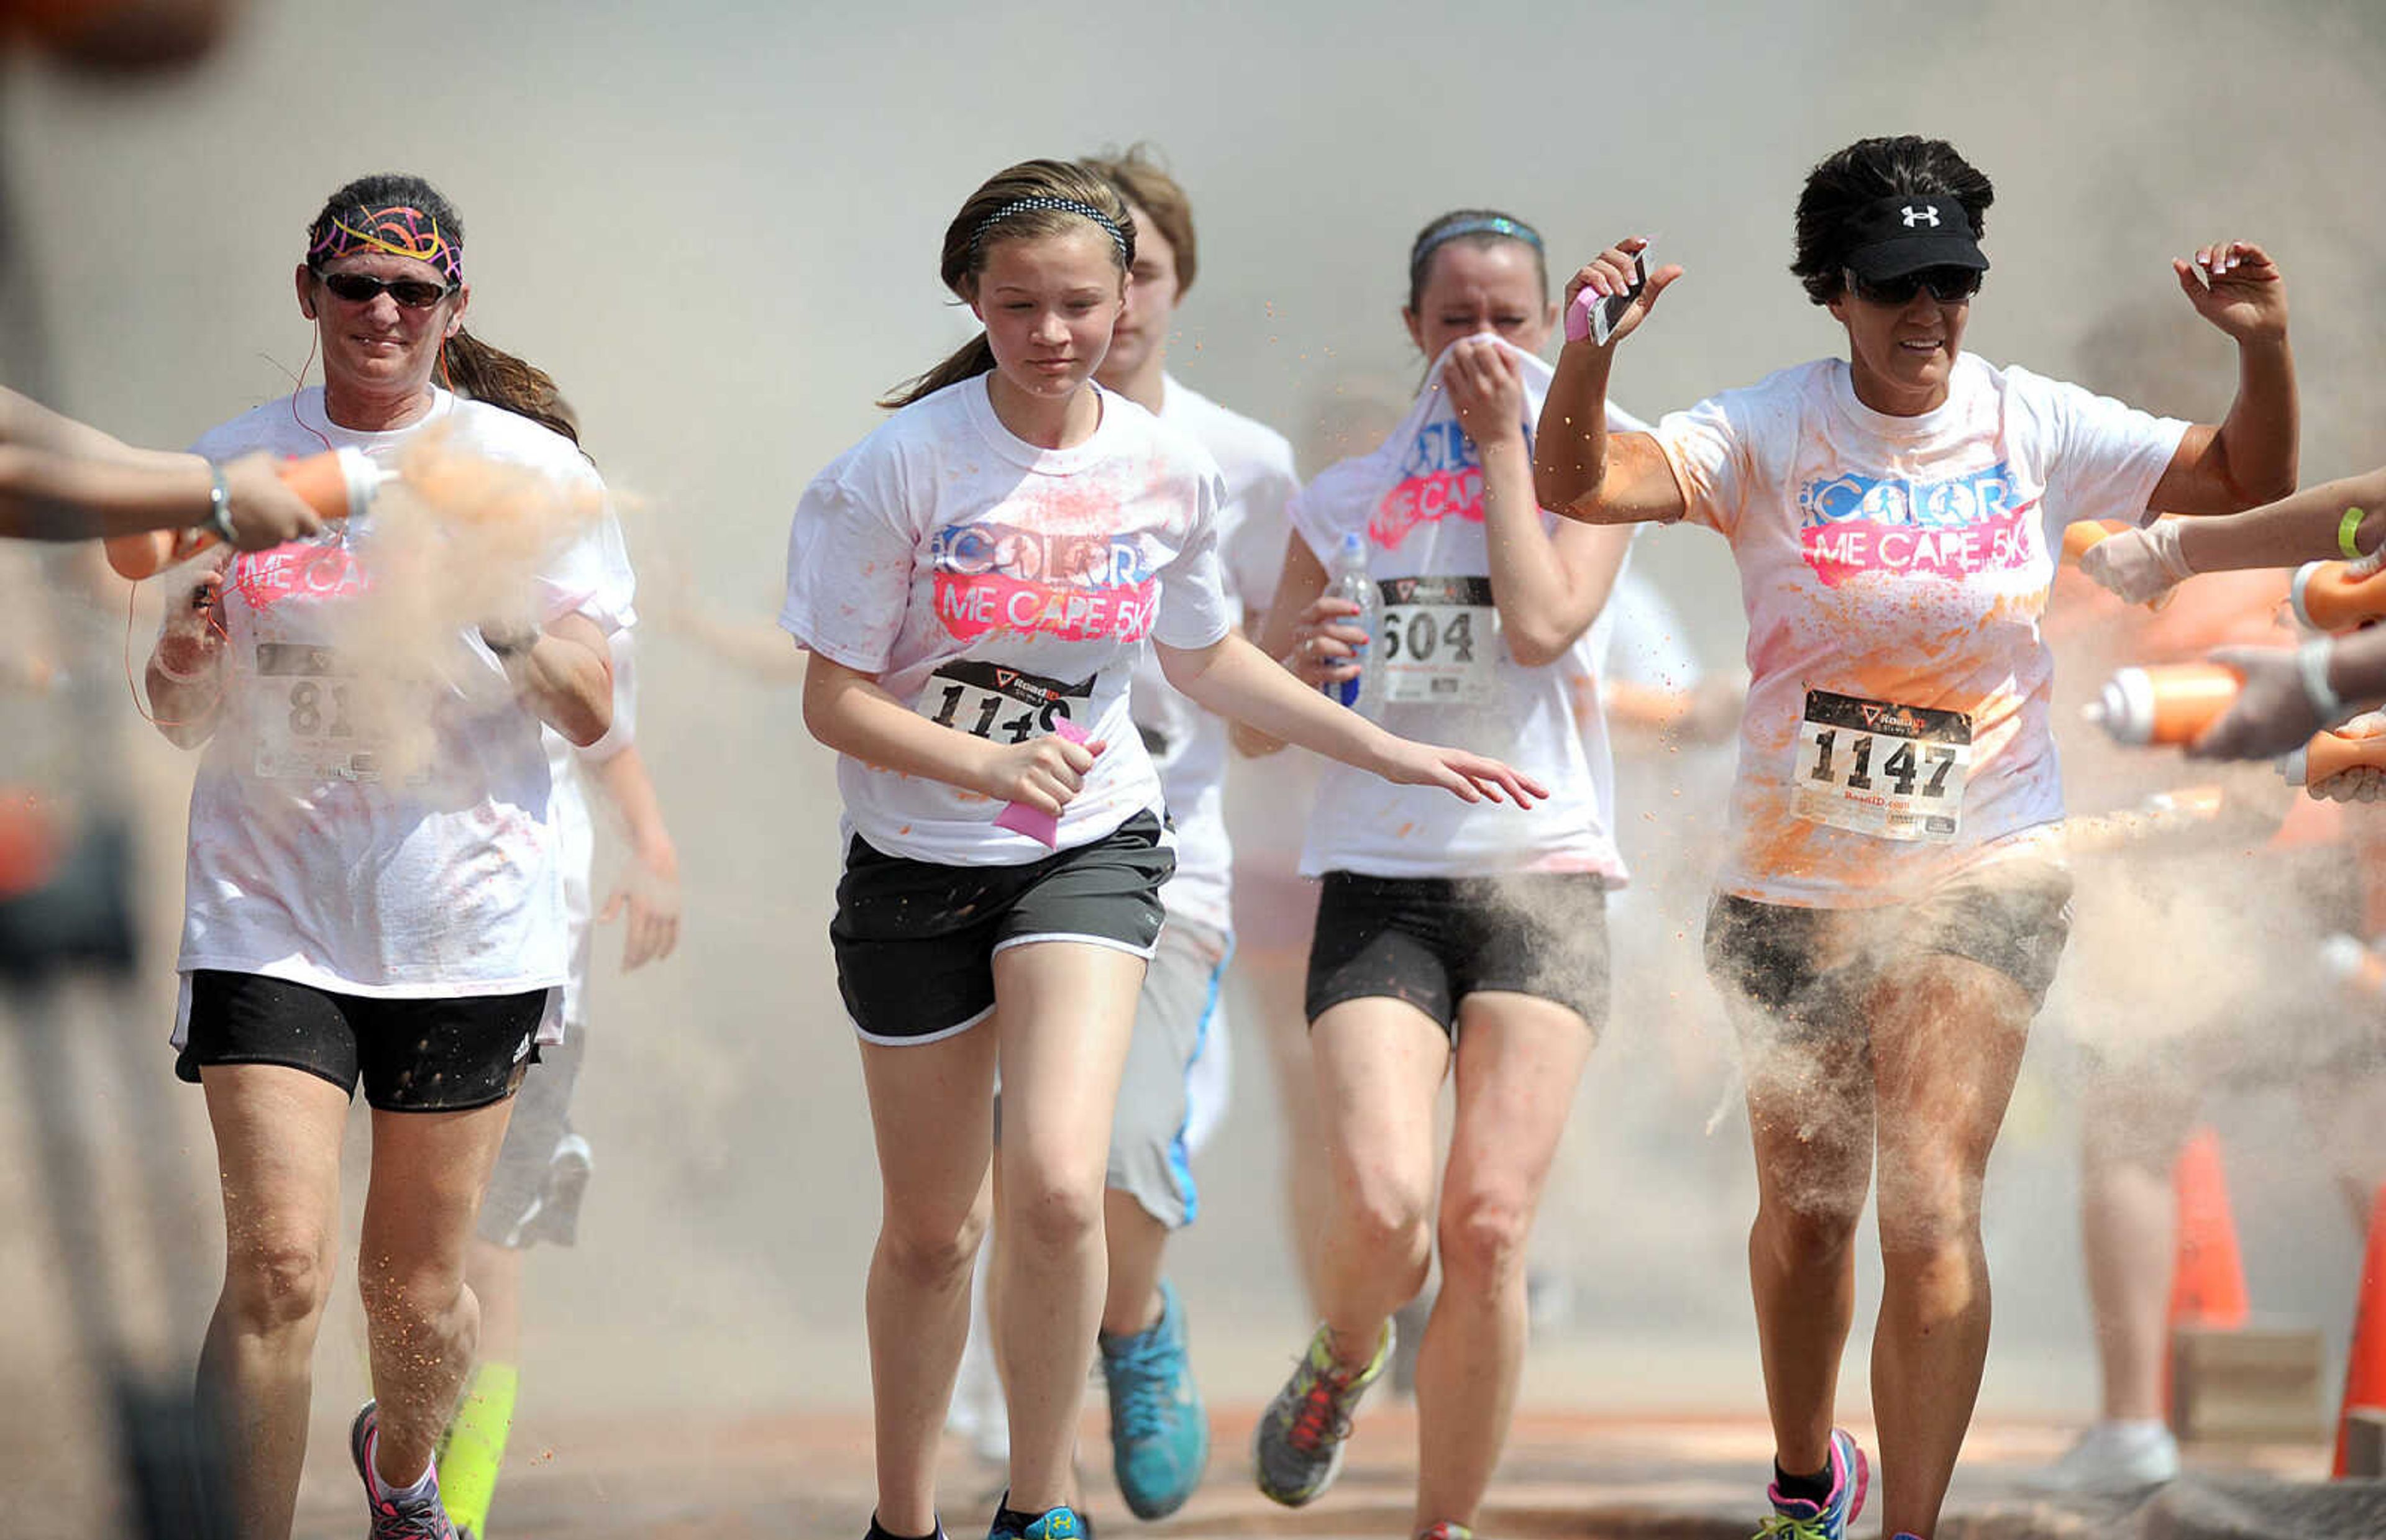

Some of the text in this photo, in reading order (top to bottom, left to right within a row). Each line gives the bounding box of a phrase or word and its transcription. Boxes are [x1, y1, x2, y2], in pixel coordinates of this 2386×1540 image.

[1815, 476, 2013, 526] COLOR
[945, 527, 1139, 593] COLOR
[1814, 532, 1866, 565] ME
[1878, 532, 1981, 569] CAPE
[942, 583, 995, 623] ME
[1007, 590, 1107, 634] CAPE
[1811, 729, 1957, 798] 1147
